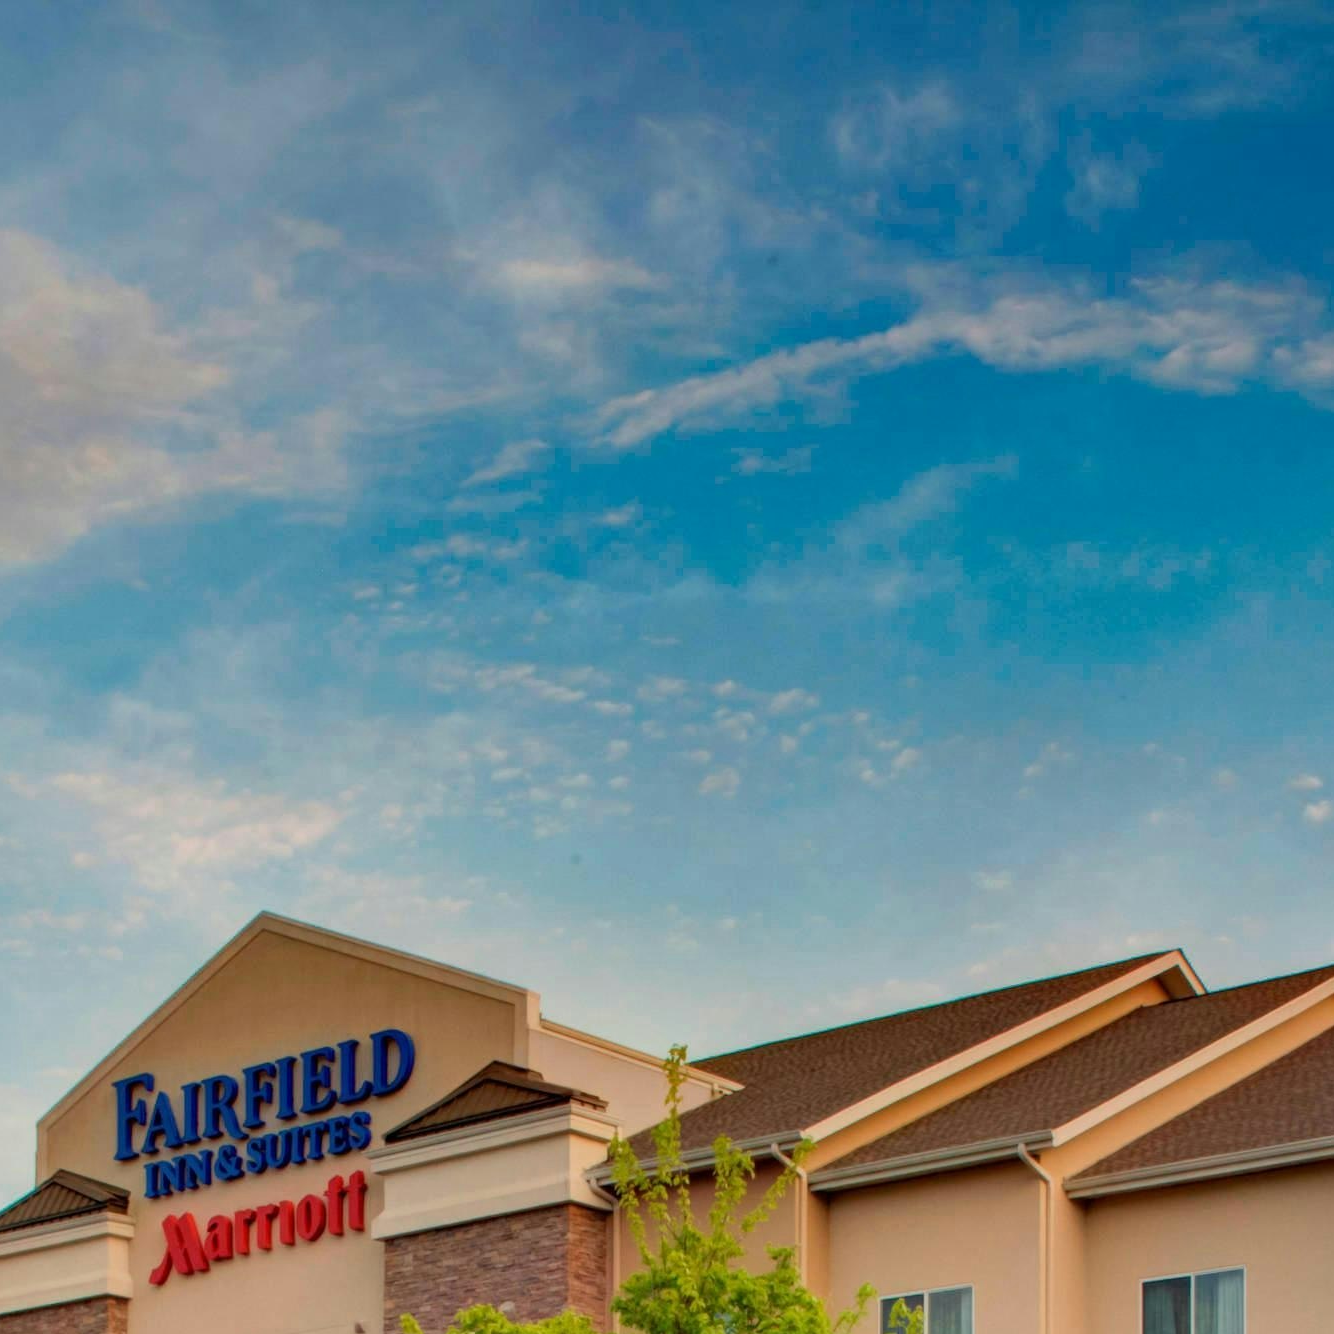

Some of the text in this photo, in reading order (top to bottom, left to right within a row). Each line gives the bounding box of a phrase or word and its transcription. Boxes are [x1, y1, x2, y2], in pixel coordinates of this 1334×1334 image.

[112, 1028, 415, 1161] FAIRFIELD
[144, 1149, 213, 1199] INN
[246, 1111, 372, 1174] SUITES
[149, 1170, 368, 1287] Marriott
